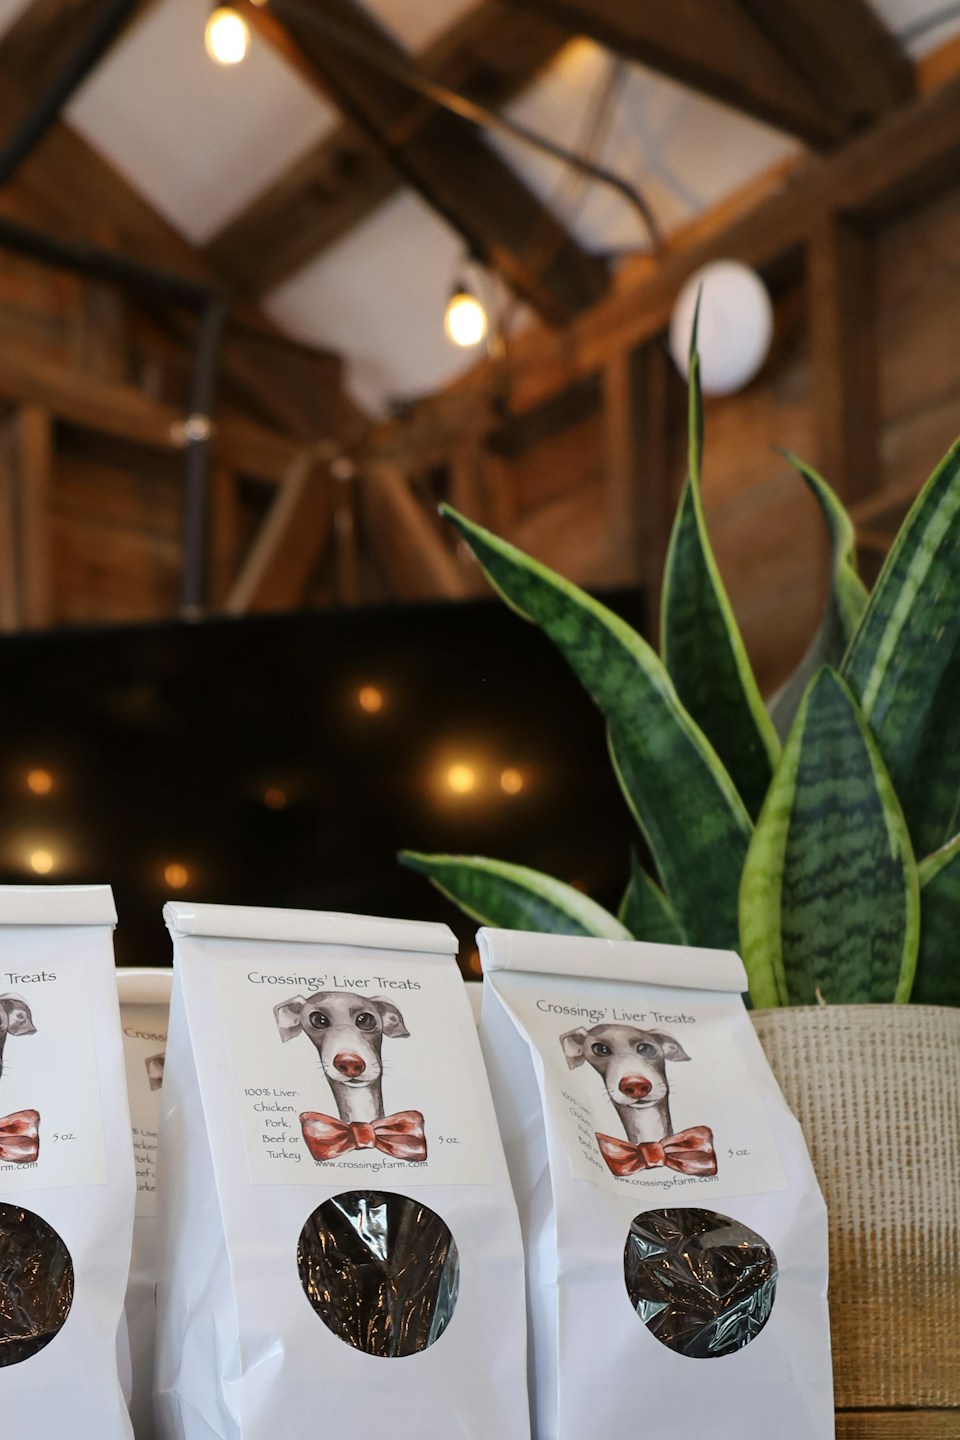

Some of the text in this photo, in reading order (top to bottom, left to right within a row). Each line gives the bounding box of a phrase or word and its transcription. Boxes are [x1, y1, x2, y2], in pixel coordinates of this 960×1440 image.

[4, 970, 57, 986] Treats
[247, 971, 422, 992] Crossings' Liver Treats
[536, 999, 696, 1025] Crossings' Liver Treats
[244, 1088, 271, 1097] 100%
[253, 1100, 297, 1113] Chicken,
[264, 1116, 292, 1129] Pork,
[52, 1132, 59, 1143] 5
[261, 1132, 286, 1143] Beef
[438, 1135, 444, 1145] 5
[266, 1147, 301, 1163] Turkey
[314, 1158, 429, 1173] www.crossingsfarm.com
